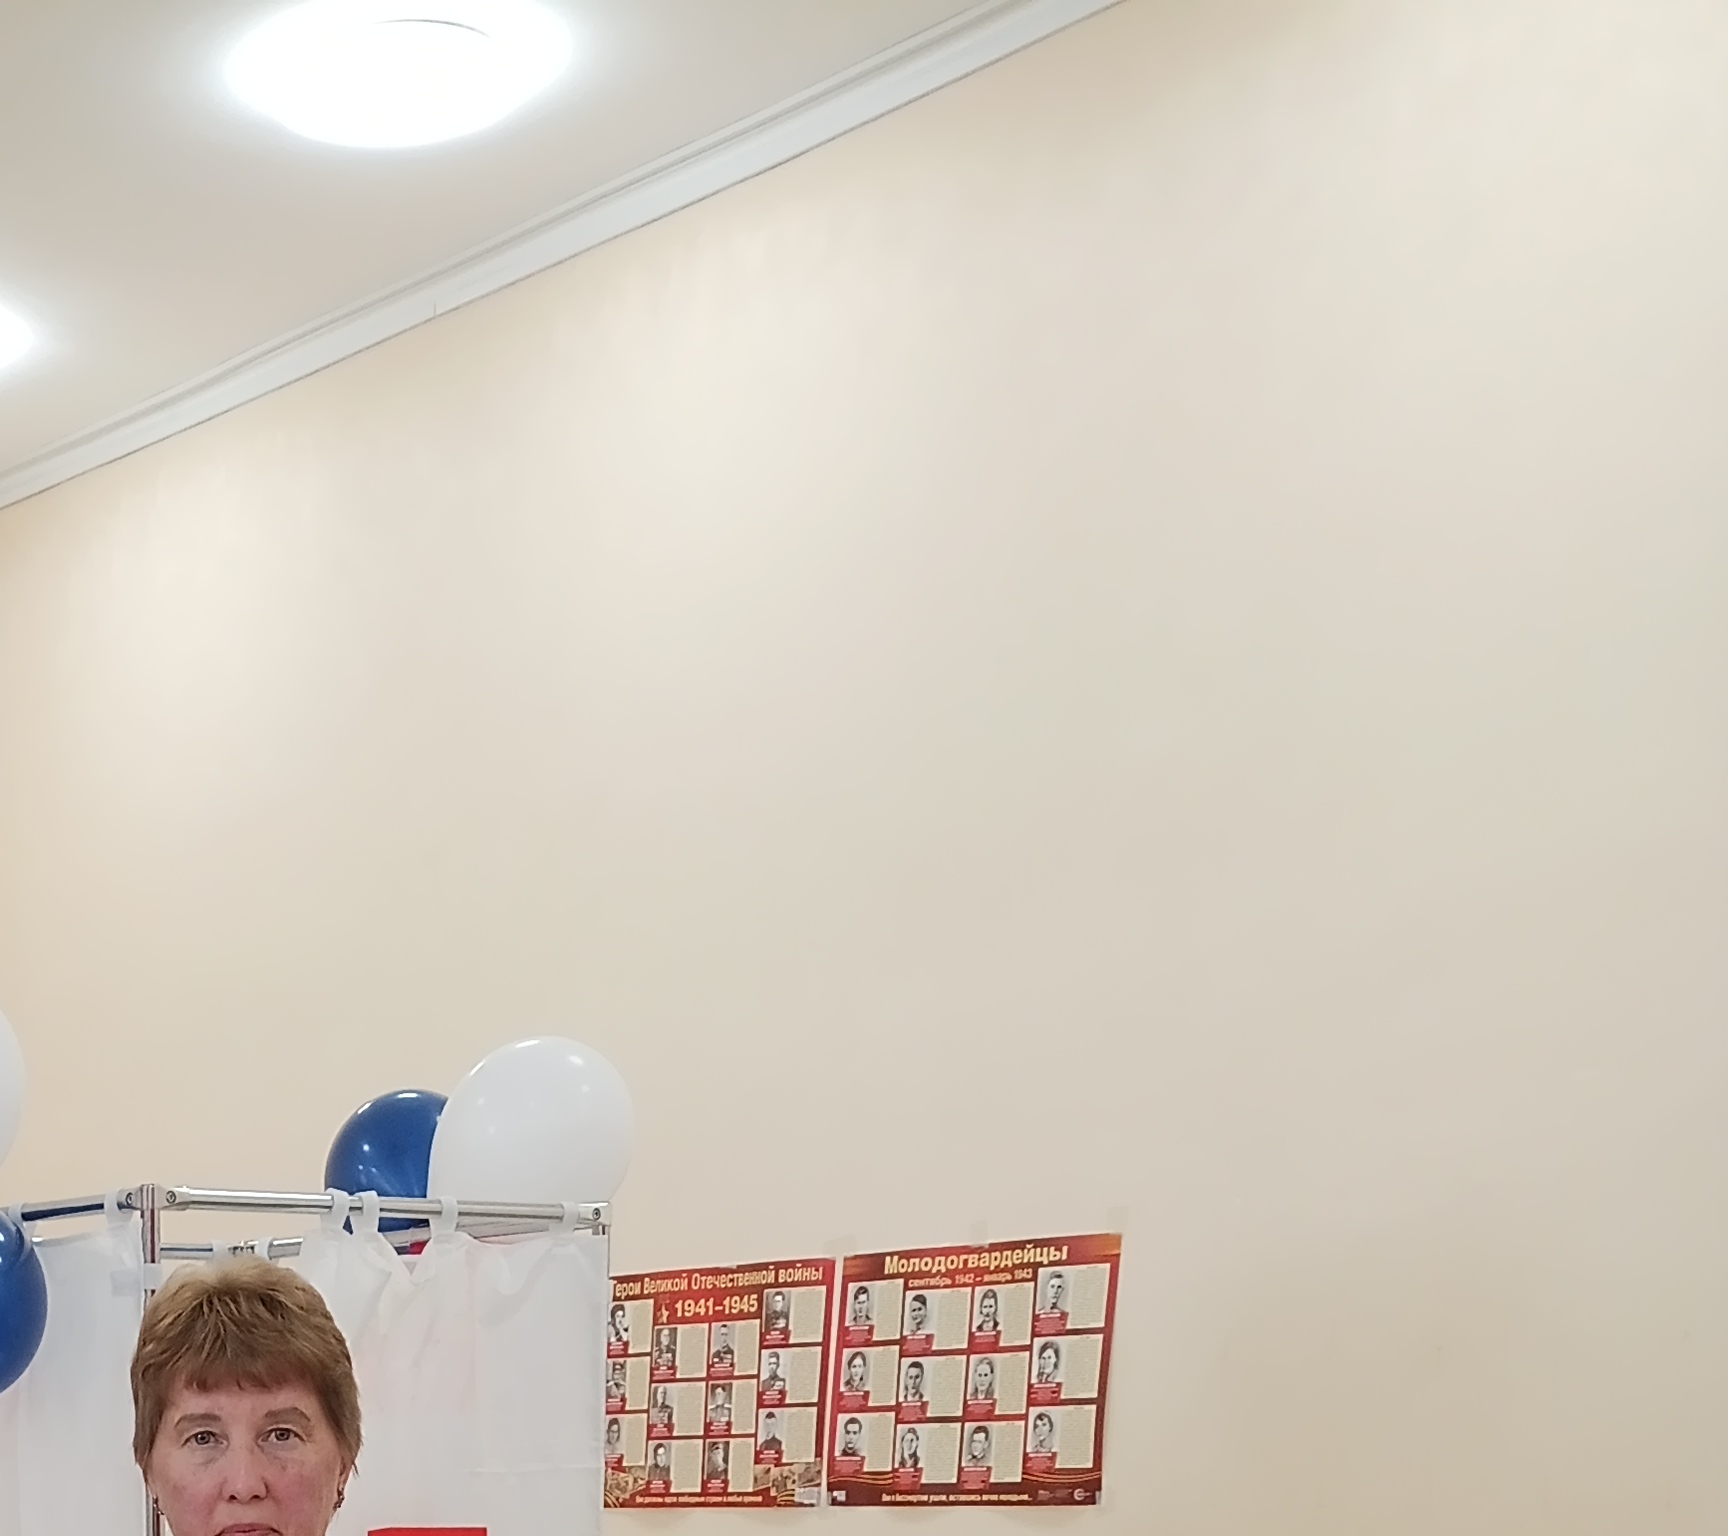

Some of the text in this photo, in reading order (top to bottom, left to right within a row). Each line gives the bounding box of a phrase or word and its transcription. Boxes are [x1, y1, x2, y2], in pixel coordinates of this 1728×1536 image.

[884, 1244, 1068, 1275] Молодогвардейцы
[613, 1263, 823, 1300] ерои Великой Отечественной войны
